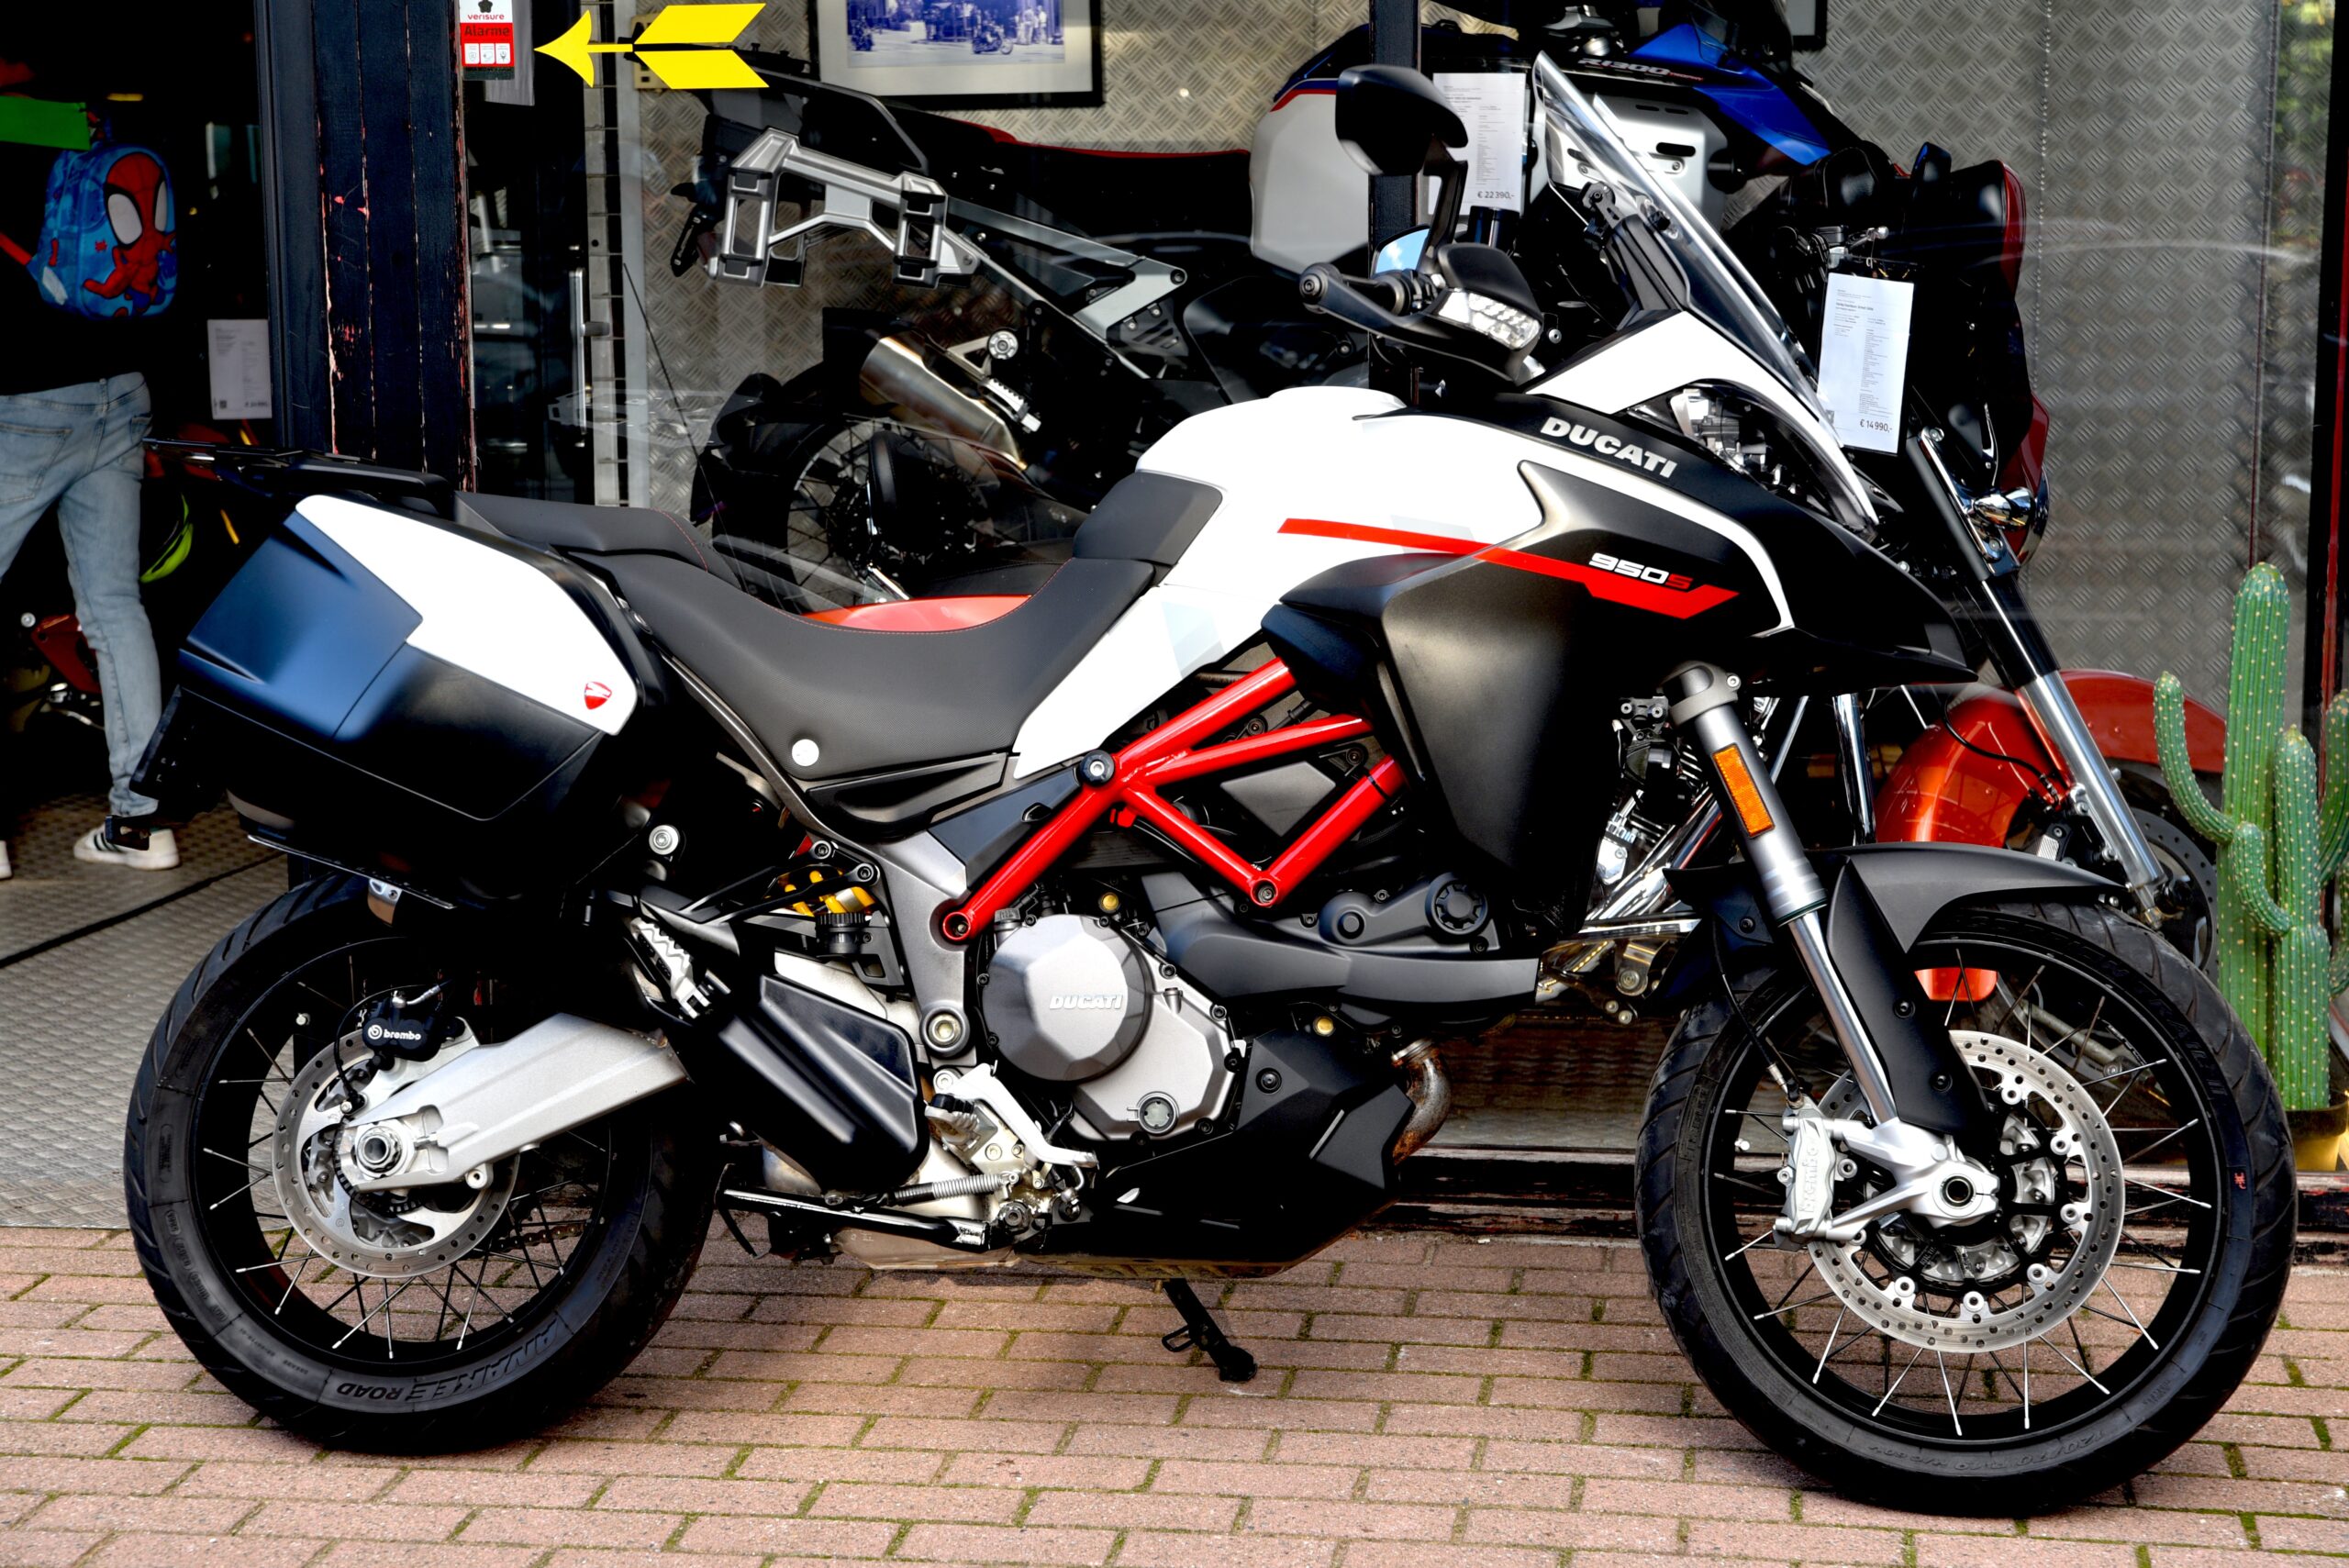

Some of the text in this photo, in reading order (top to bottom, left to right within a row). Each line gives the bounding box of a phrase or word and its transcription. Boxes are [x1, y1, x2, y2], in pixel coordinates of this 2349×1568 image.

[464, 25, 510, 37] Alarme
[1540, 417, 1678, 479] DUCATI
[1588, 552, 1694, 590] 950S
[1049, 995, 1123, 1010] DUCATI
[384, 1029, 422, 1040] brembo
[1798, 1138, 1819, 1213] brembo
[337, 1318, 558, 1402] ANAKEE ROAD
